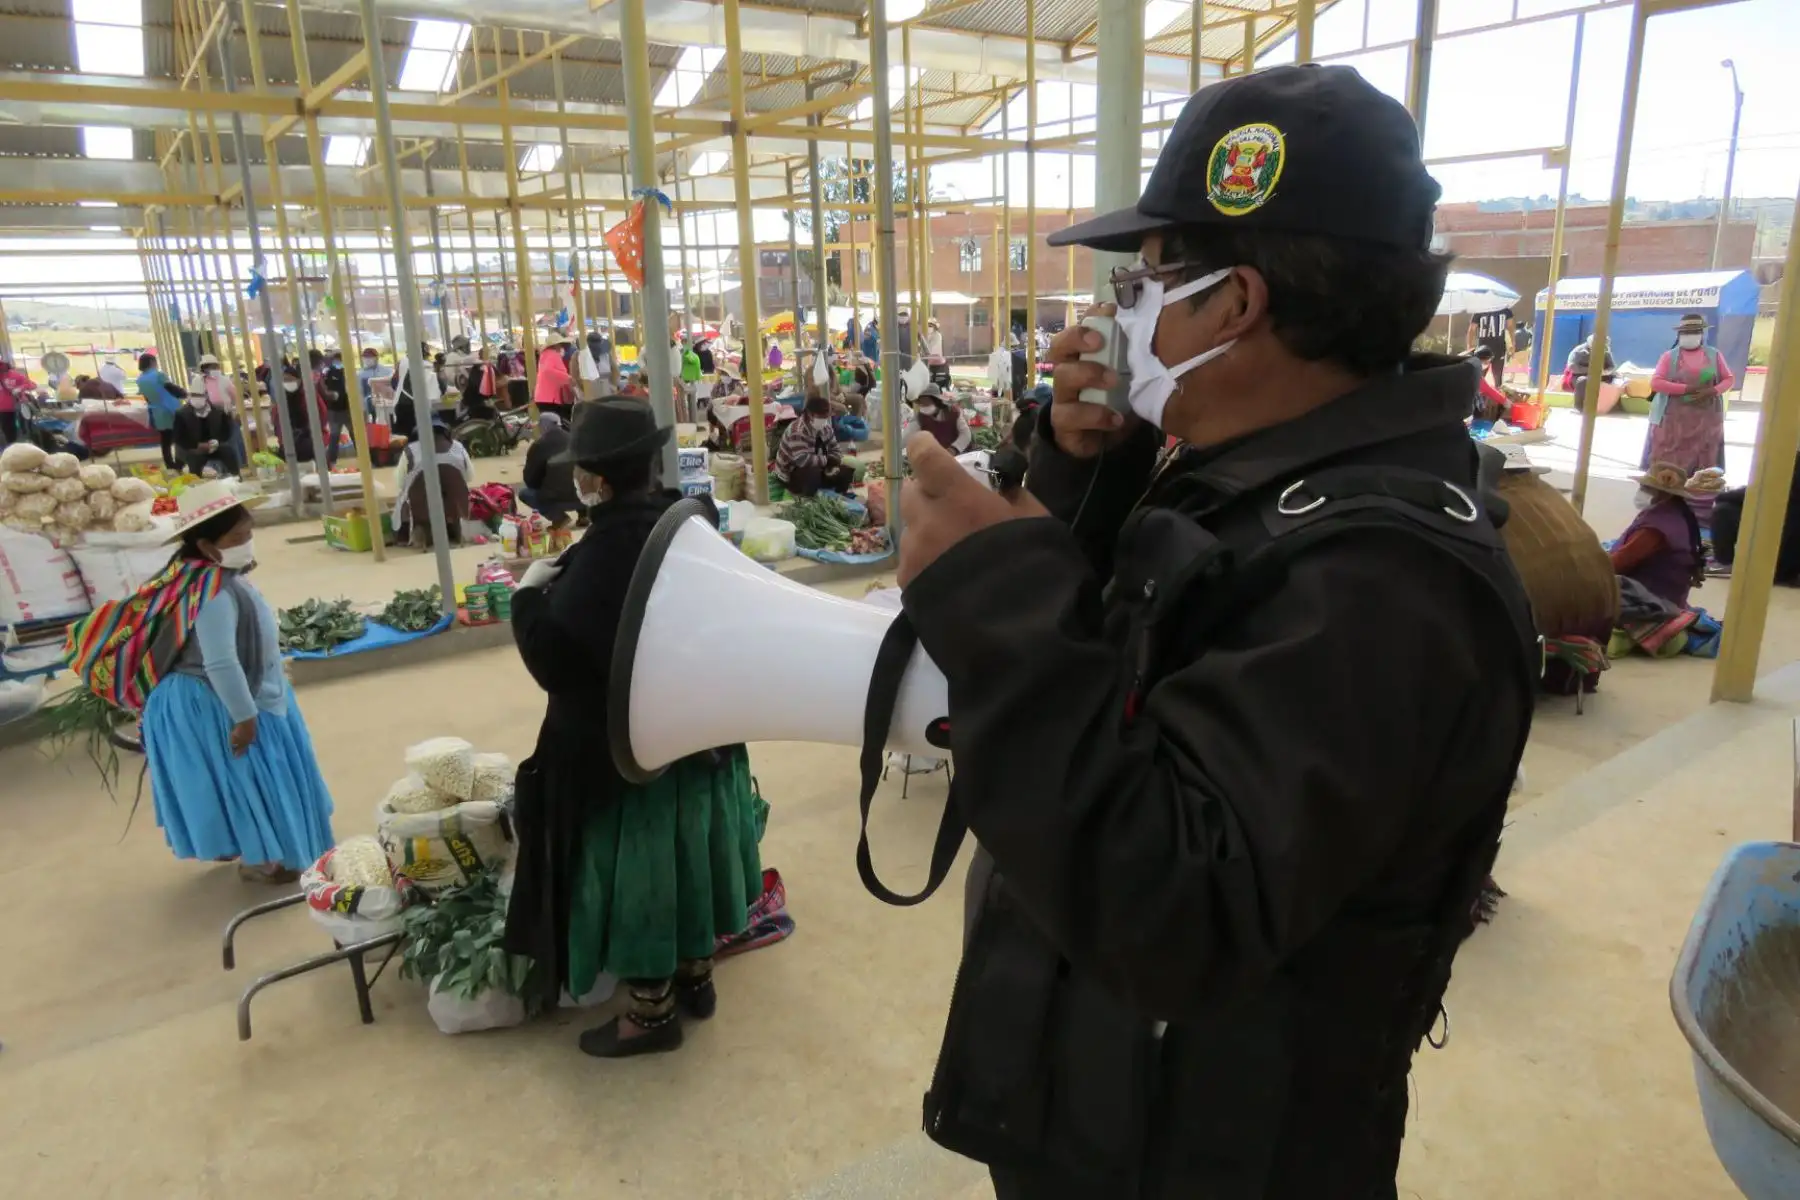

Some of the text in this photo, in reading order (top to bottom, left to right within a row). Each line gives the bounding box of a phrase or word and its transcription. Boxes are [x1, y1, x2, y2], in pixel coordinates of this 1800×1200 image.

[1642, 298, 1673, 306] NUEVO
[1675, 297, 1703, 305] PUNO
[681, 456, 702, 467] Elite
